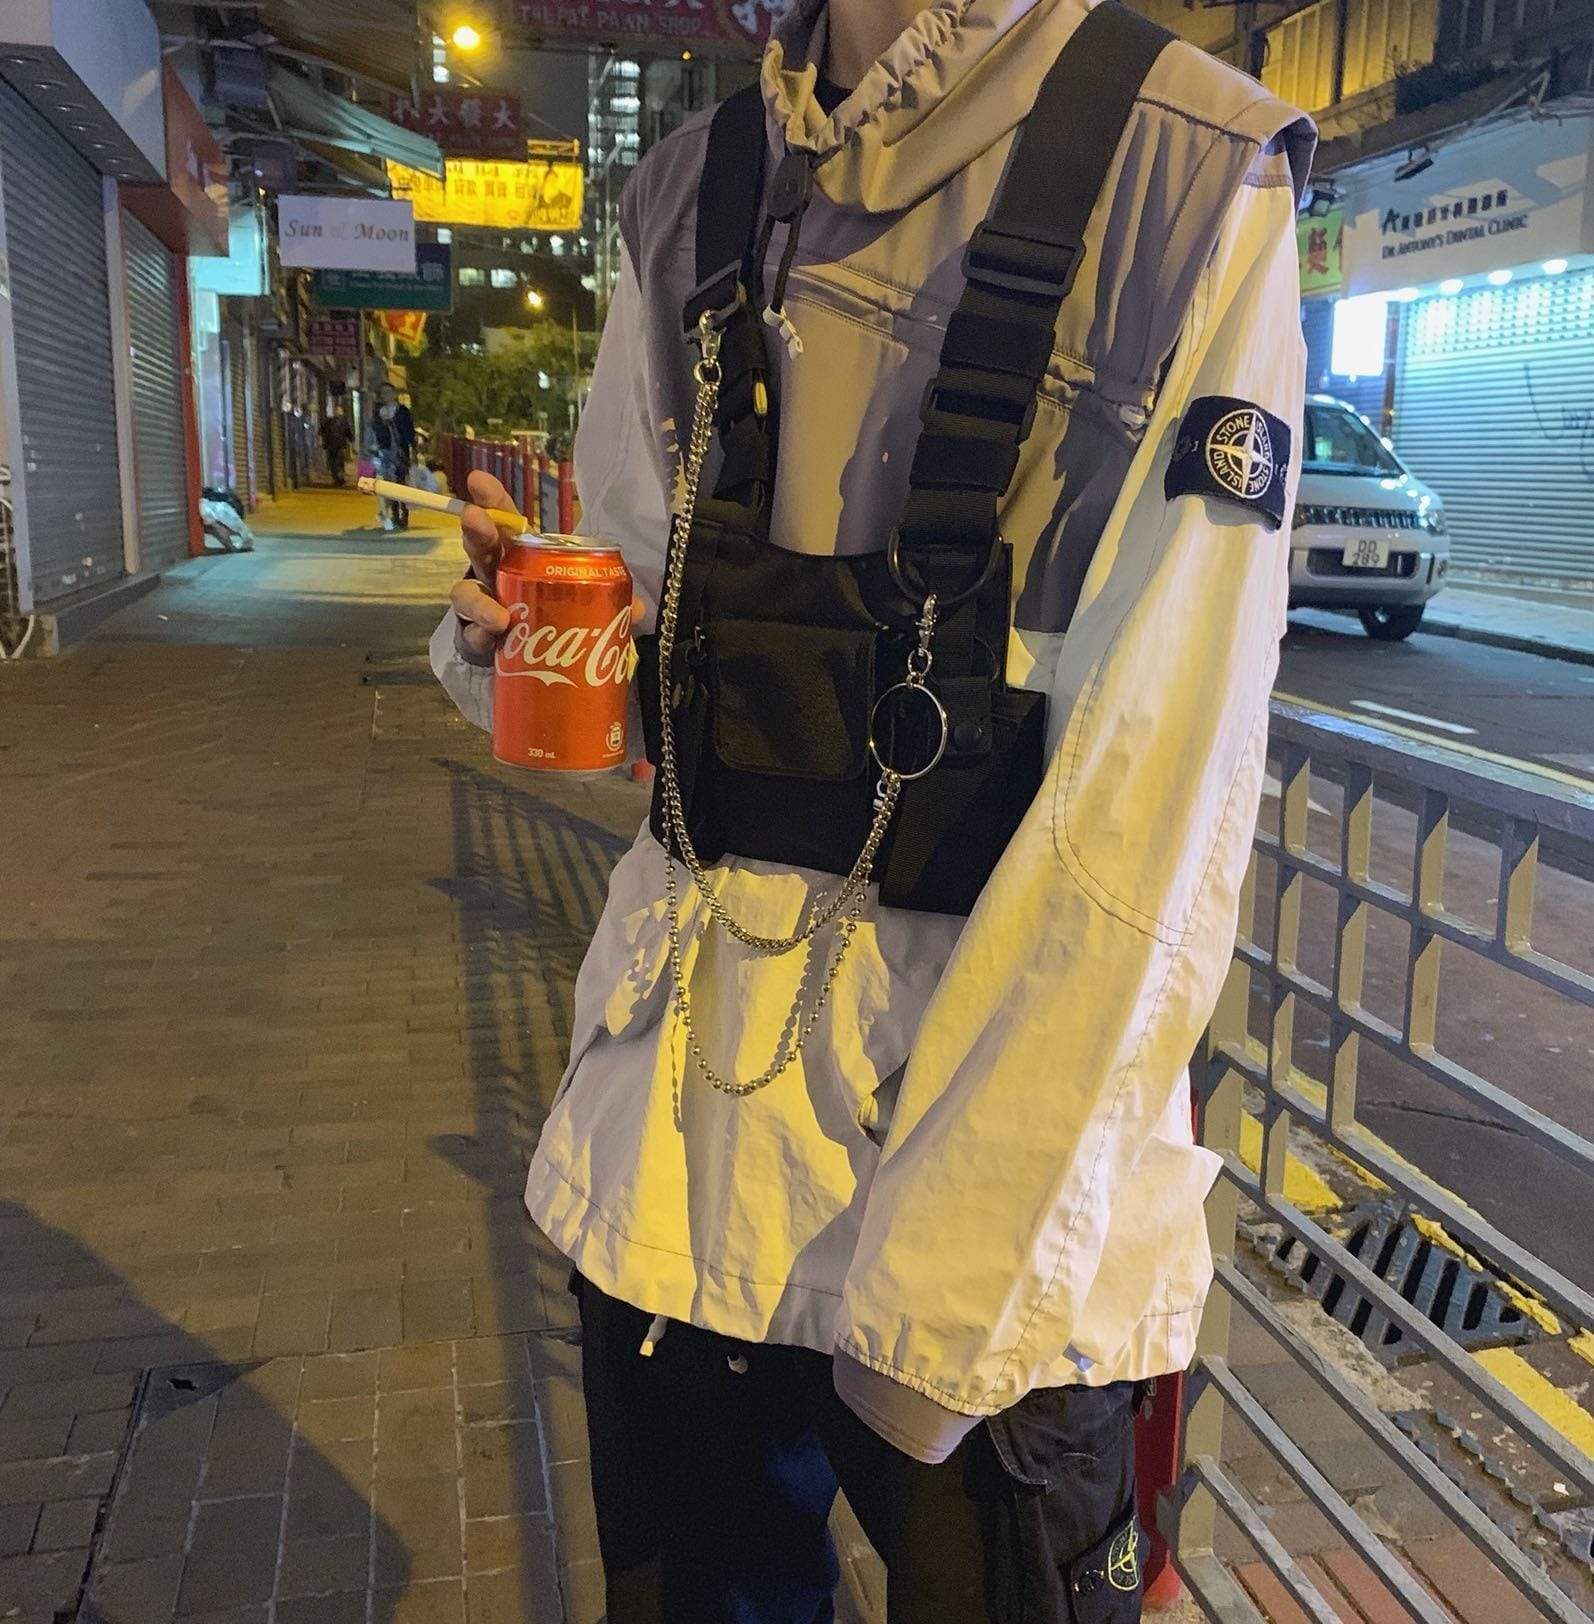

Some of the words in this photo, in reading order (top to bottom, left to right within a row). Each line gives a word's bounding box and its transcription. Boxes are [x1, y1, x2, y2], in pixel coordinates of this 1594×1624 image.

[285, 220, 322, 238] Sun
[354, 223, 408, 242] Moon
[1216, 415, 1250, 443] STONE
[1256, 420, 1270, 460] ISLAND
[1213, 452, 1242, 488] ISLAND
[1250, 465, 1269, 492] STONE
[545, 565, 602, 578] ORIGINAL
[603, 566, 627, 577] TASTE
[528, 747, 543, 758] 330
